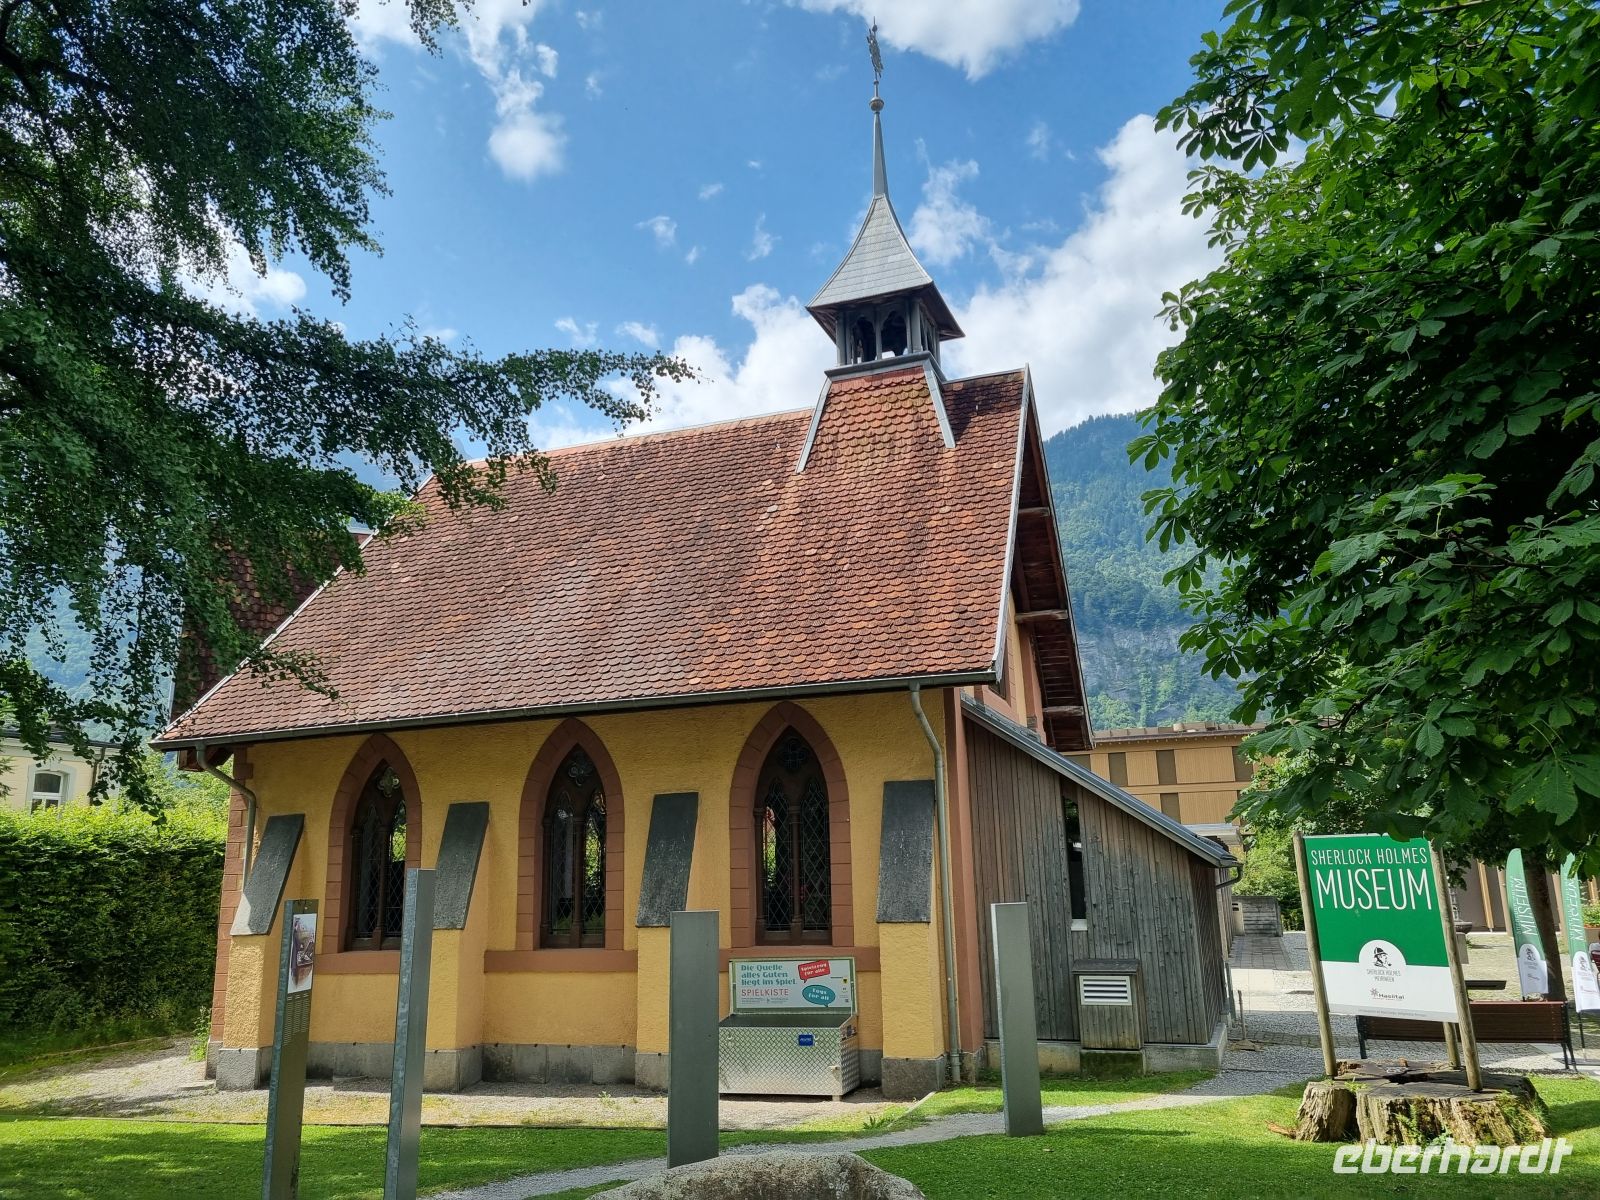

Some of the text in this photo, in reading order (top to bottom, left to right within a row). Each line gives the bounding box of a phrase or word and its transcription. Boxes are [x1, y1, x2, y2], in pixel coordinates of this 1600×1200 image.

[1311, 847, 1428, 865] SHERLOCK HOLMES
[1315, 868, 1432, 910] MUSEUM
[1512, 878, 1538, 936] MUSEUM
[756, 964, 783, 972] Quelle
[741, 988, 789, 997] SPIELKISTE
